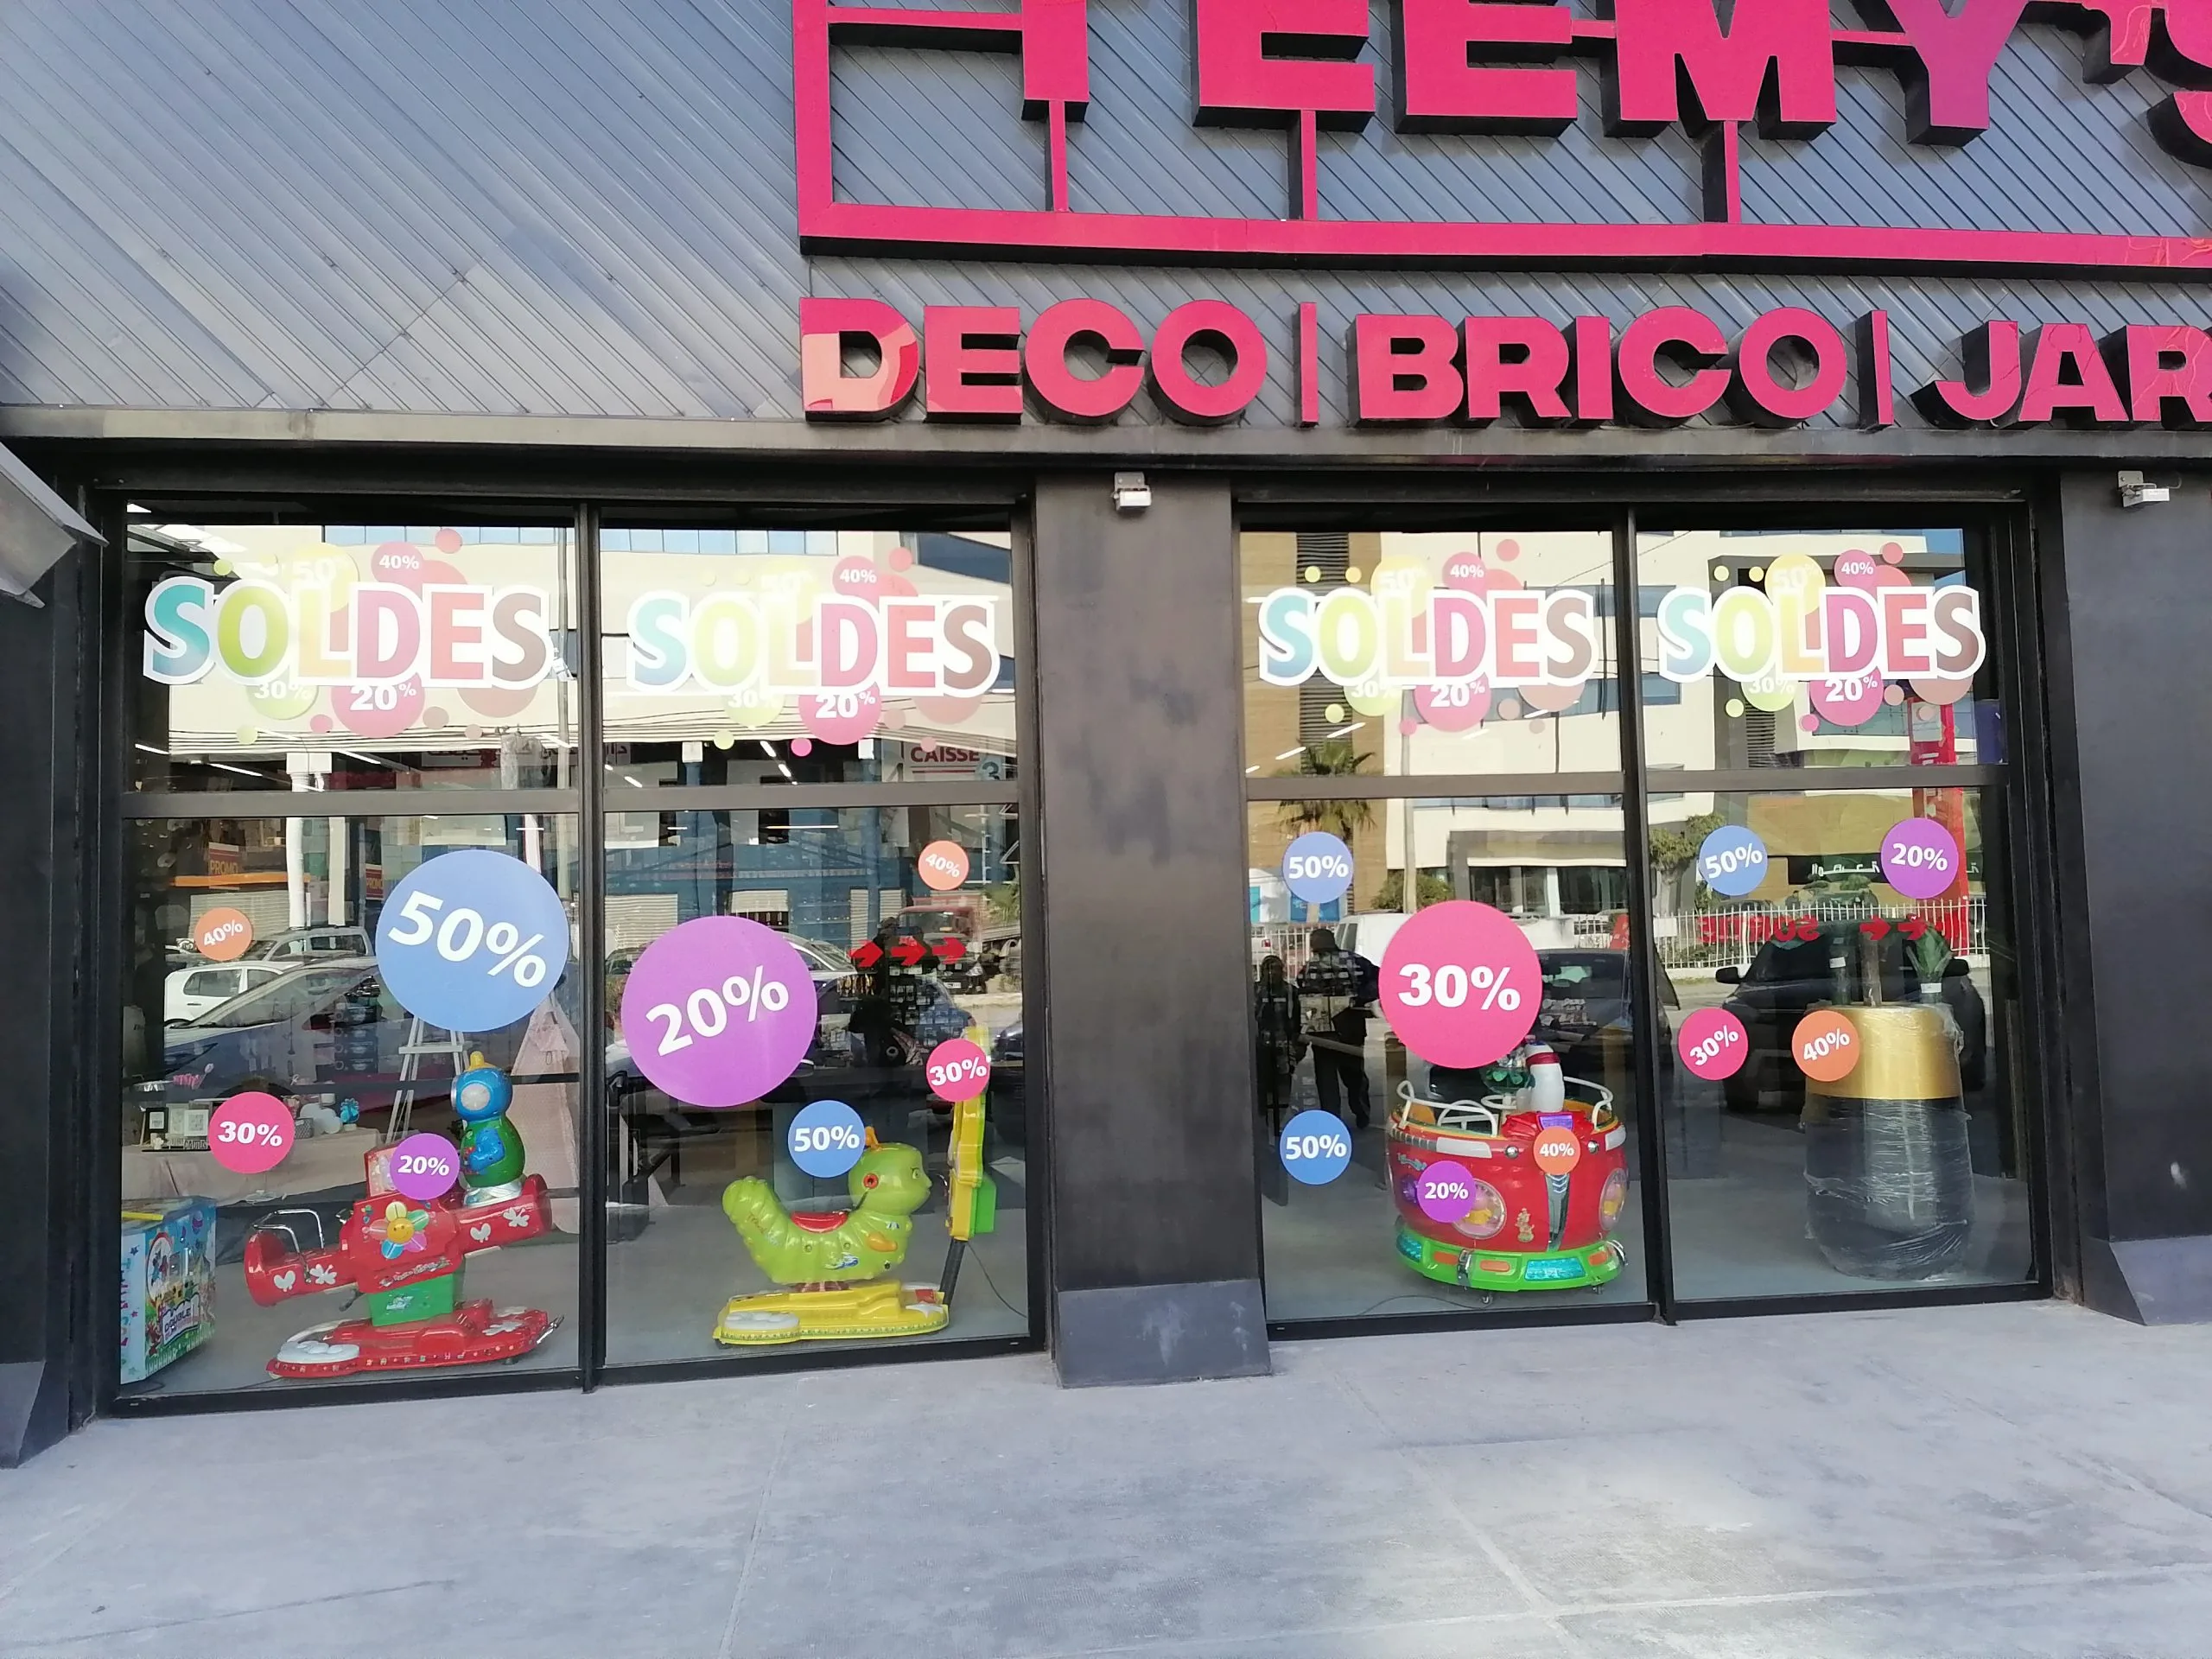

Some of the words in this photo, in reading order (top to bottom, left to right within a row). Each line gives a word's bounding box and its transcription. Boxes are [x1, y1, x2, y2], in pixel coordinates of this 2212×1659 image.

[800, 297, 1268, 422] DECO
[1352, 306, 1847, 423] BRICO
[378, 554, 420, 570] 40%
[839, 569, 877, 584] 40%
[1450, 564, 1484, 578] 40%
[1841, 561, 1874, 575] 40%
[144, 577, 551, 689] SOLDES
[627, 592, 1001, 697] SOLDES
[1259, 588, 1599, 686] SOLDES
[1658, 586, 1986, 683] SOLDES
[350, 682, 416, 711] 20%
[1430, 680, 1485, 708] 20%
[1825, 675, 1878, 702] 20%
[815, 689, 876, 718] 20%
[925, 853, 961, 878] 40%
[1288, 855, 1349, 880] 50%
[1705, 842, 1763, 880] 50%
[1890, 842, 1948, 872] 20%
[203, 918, 244, 948] 40%
[388, 890, 546, 988] 50%
[1397, 963, 1521, 1011] 30%
[645, 964, 789, 1057] 20%
[1690, 1025, 1738, 1066] 30%
[1803, 1027, 1850, 1062] 40%
[929, 1056, 987, 1086] 30%
[218, 1122, 283, 1147] 30%
[794, 1126, 860, 1153] 50%
[1285, 1134, 1346, 1160] 50%
[1539, 1141, 1574, 1157] 40%
[397, 1155, 449, 1176] 20%
[1425, 1181, 1469, 1200] 20%
